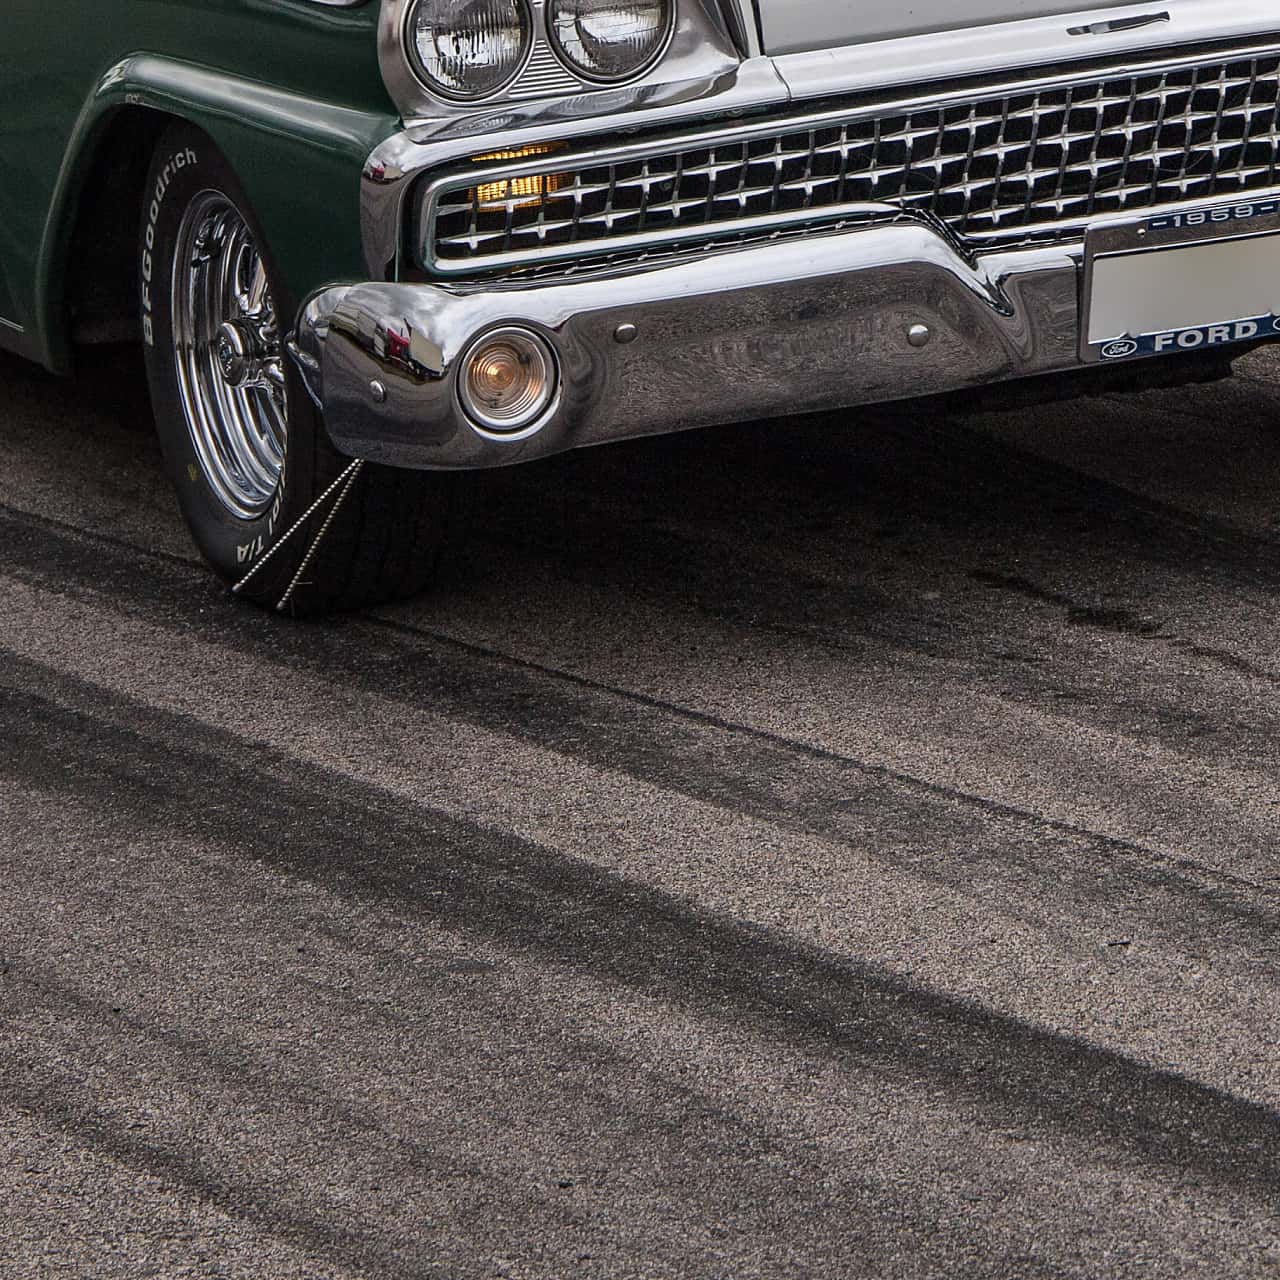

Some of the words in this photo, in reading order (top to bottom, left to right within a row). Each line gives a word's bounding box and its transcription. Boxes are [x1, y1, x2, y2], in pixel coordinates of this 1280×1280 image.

[141, 147, 198, 346] BFGoodrich
[1154, 321, 1258, 352] FORD
[236, 535, 265, 563] T/A
